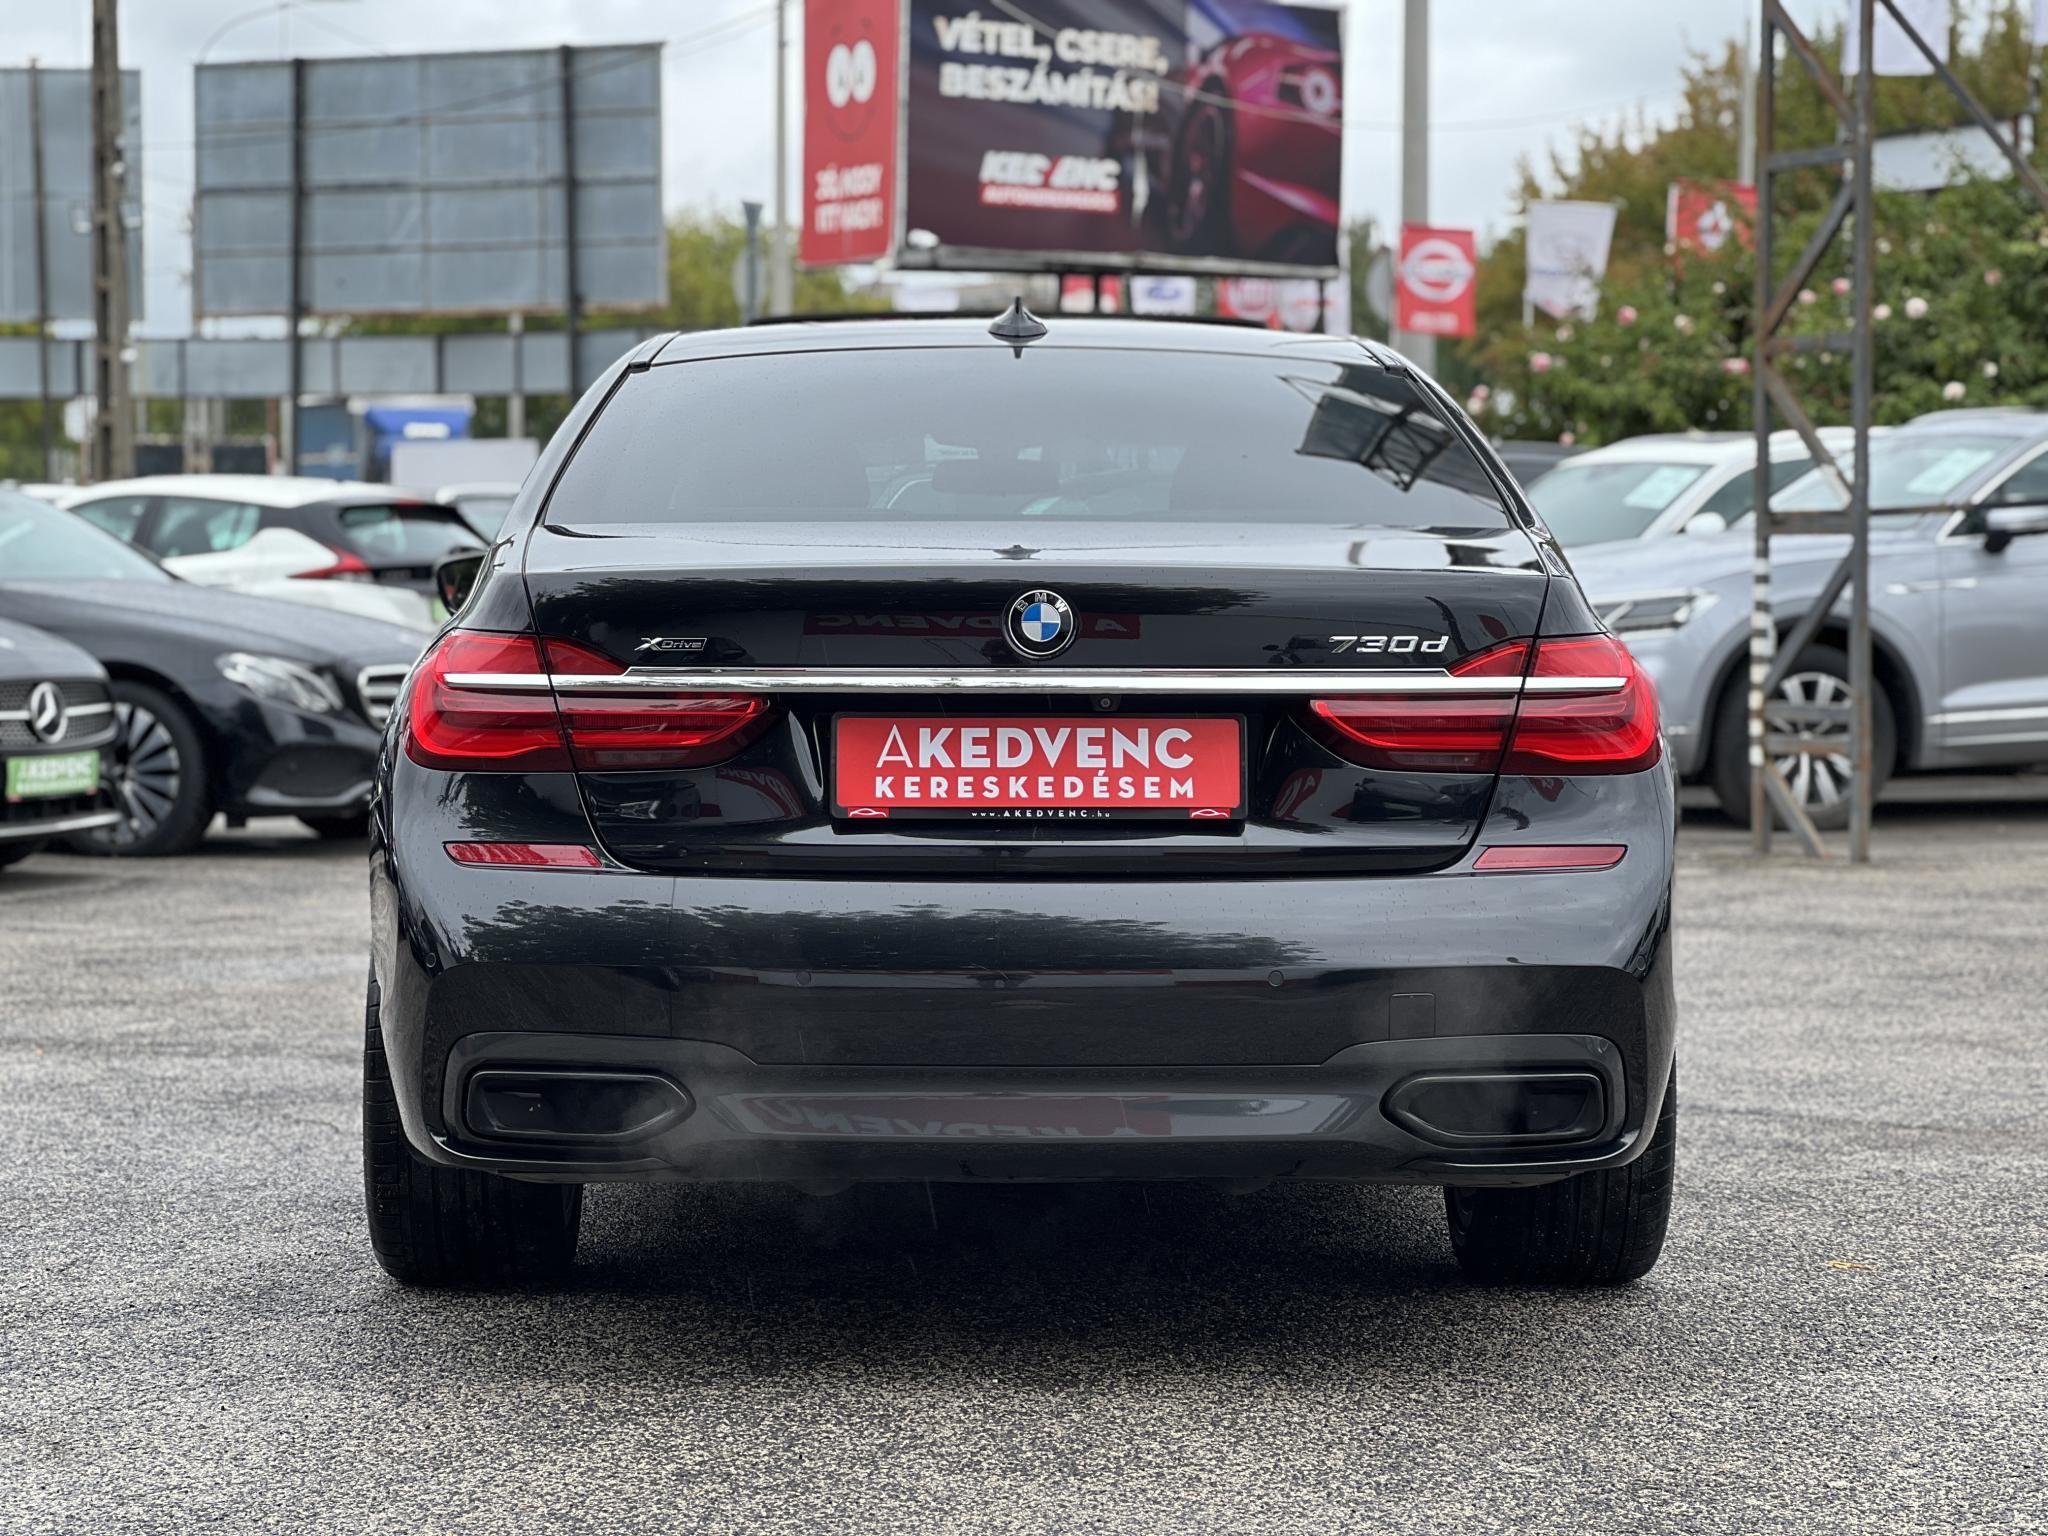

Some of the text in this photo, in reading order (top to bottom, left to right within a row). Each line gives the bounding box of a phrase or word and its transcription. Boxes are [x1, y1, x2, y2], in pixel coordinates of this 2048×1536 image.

[1015, 592, 1067, 613] BMW
[1328, 636, 1449, 653] 730d
[875, 770, 1194, 799] KERESKEDÉSEM
[970, 809, 1110, 819] www.AKEDVENC.hu
